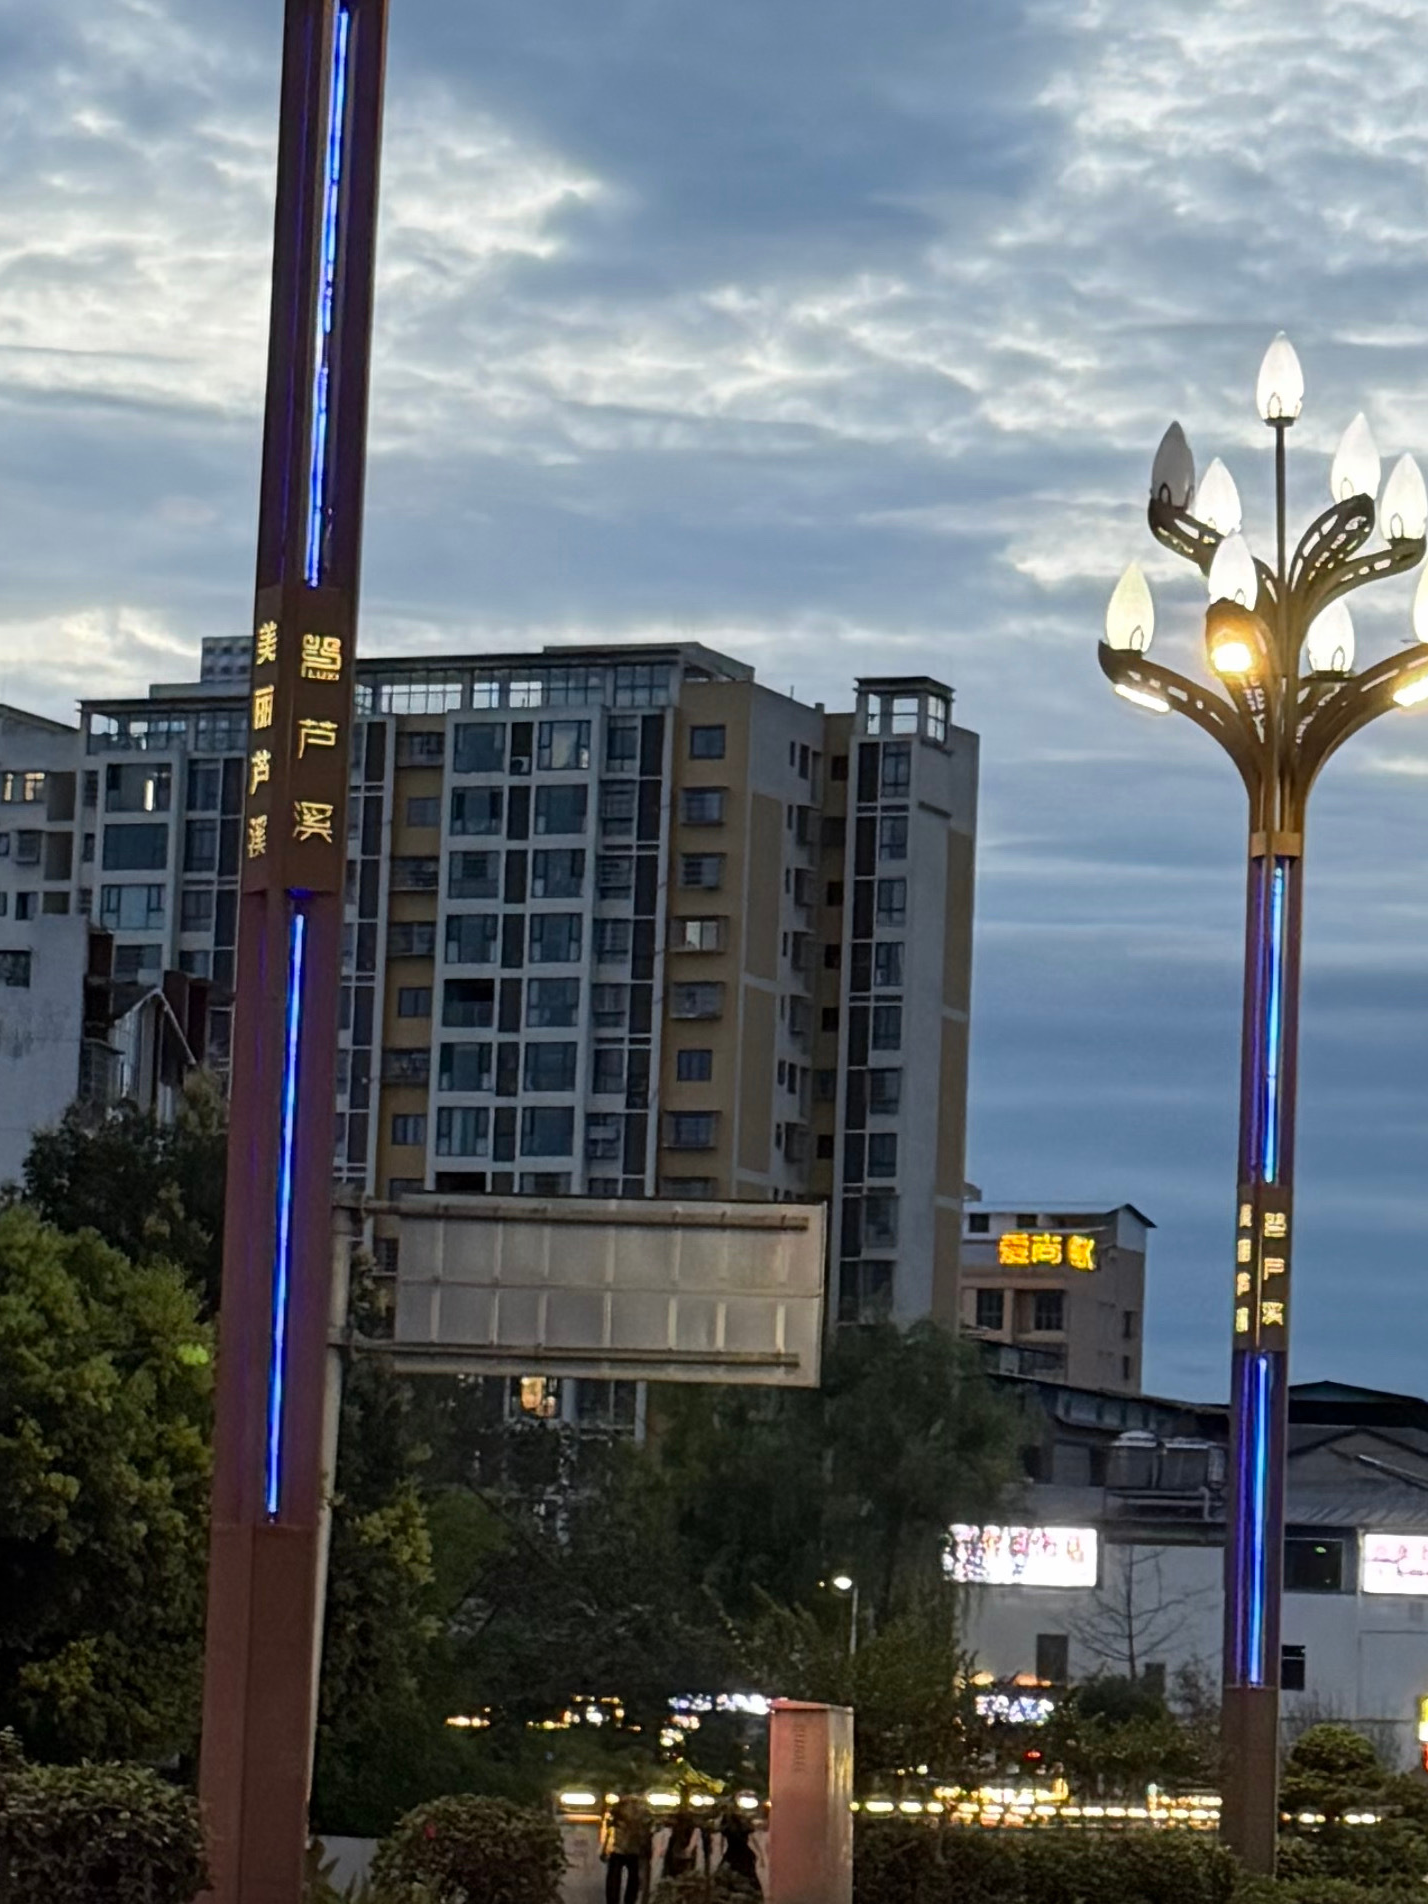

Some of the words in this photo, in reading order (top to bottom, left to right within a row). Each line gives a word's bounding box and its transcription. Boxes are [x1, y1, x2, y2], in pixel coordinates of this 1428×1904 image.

[249, 621, 278, 858] 美丽芦溪
[293, 718, 339, 843] 芦溪
